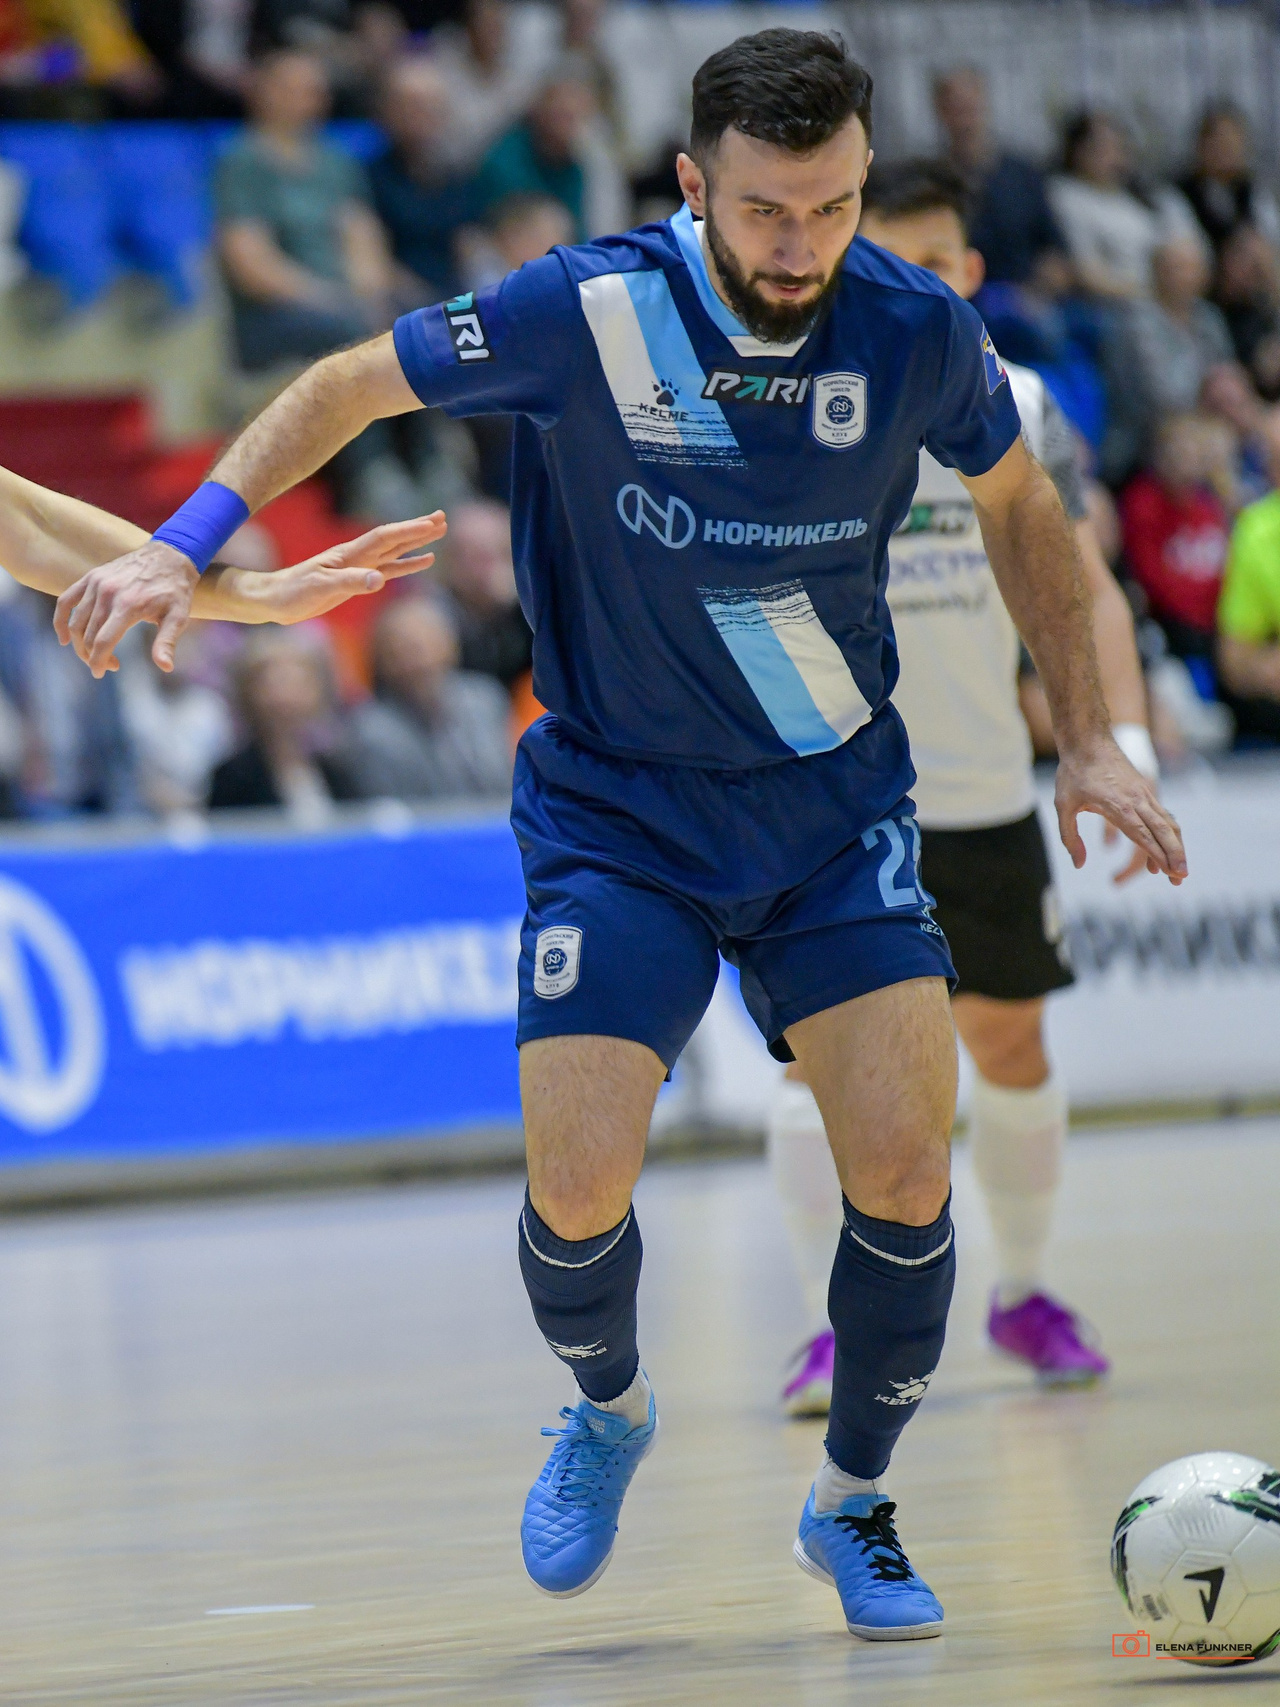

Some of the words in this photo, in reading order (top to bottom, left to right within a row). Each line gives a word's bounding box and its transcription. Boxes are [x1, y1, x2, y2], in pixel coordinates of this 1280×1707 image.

[704, 371, 809, 404] PARI
[638, 402, 689, 421] KELME
[703, 518, 869, 547] НОРНИКЕЛЬ
